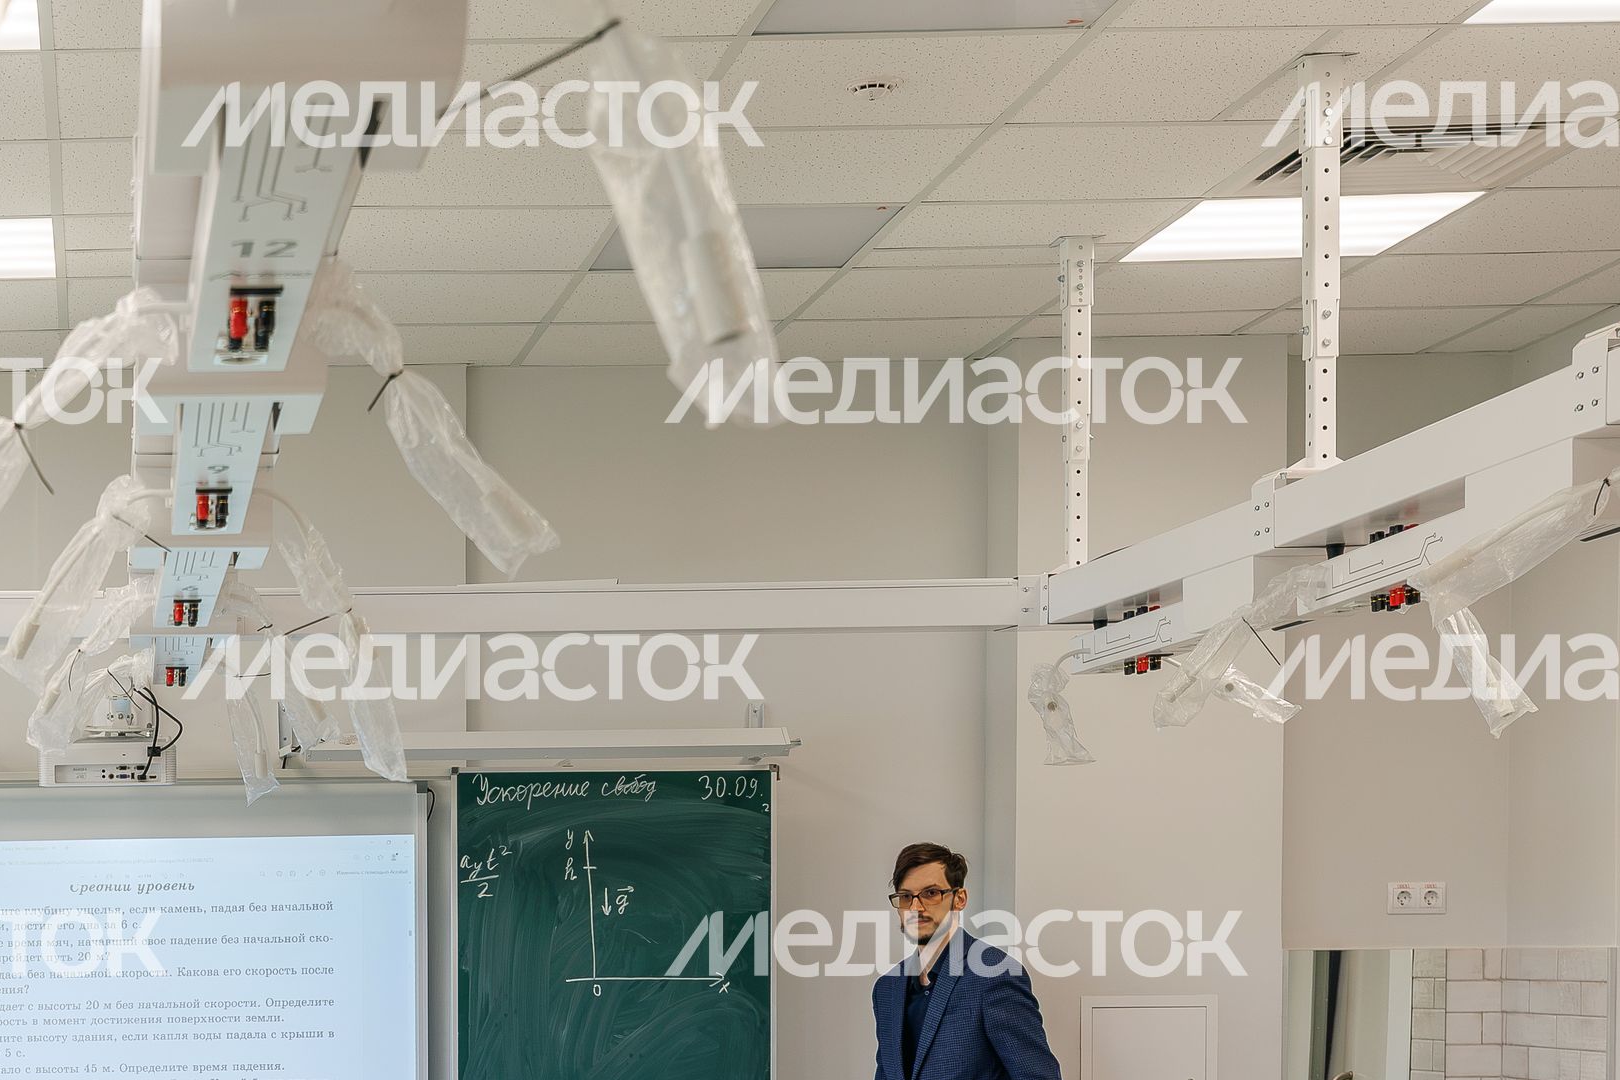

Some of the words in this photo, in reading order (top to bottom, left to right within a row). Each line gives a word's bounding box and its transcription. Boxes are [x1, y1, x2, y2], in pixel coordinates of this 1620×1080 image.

[230, 241, 298, 258] 12
[471, 773, 590, 811] Ускорение
[136, 881, 195, 894] уровень
[159, 904, 207, 916] камень,
[209, 904, 245, 916] падая
[247, 901, 268, 913] без
[270, 900, 334, 913] начальной
[169, 936, 217, 948] падение
[219, 934, 240, 945] без
[242, 933, 306, 945] начальной
[176, 966, 219, 978] Какова
[221, 968, 242, 977] его
[244, 967, 298, 979] скорость
[300, 966, 334, 976] после
[37, 1002, 81, 1012] высоты
[114, 999, 133, 1011] без
[137, 998, 200, 1011] начальной
[203, 999, 260, 1012] скорости.
[265, 996, 334, 1011] Определите
[42, 1017, 86, 1027] момент
[89, 1016, 163, 1028] достижения
[165, 1015, 241, 1027] поверхности
[244, 1014, 284, 1024] земли.
[25, 1033, 68, 1045] высоту
[71, 1032, 118, 1044] здания,
[120, 1032, 148, 1042] если
[150, 1031, 188, 1041] капля
[191, 1031, 222, 1043] воды
[224, 1030, 267, 1042] падала
[280, 1029, 324, 1042] крыши
[33, 1065, 79, 1075] высоты
[118, 1061, 188, 1076] Определите
[192, 1063, 228, 1075] время
[230, 1062, 285, 1074] падения.
